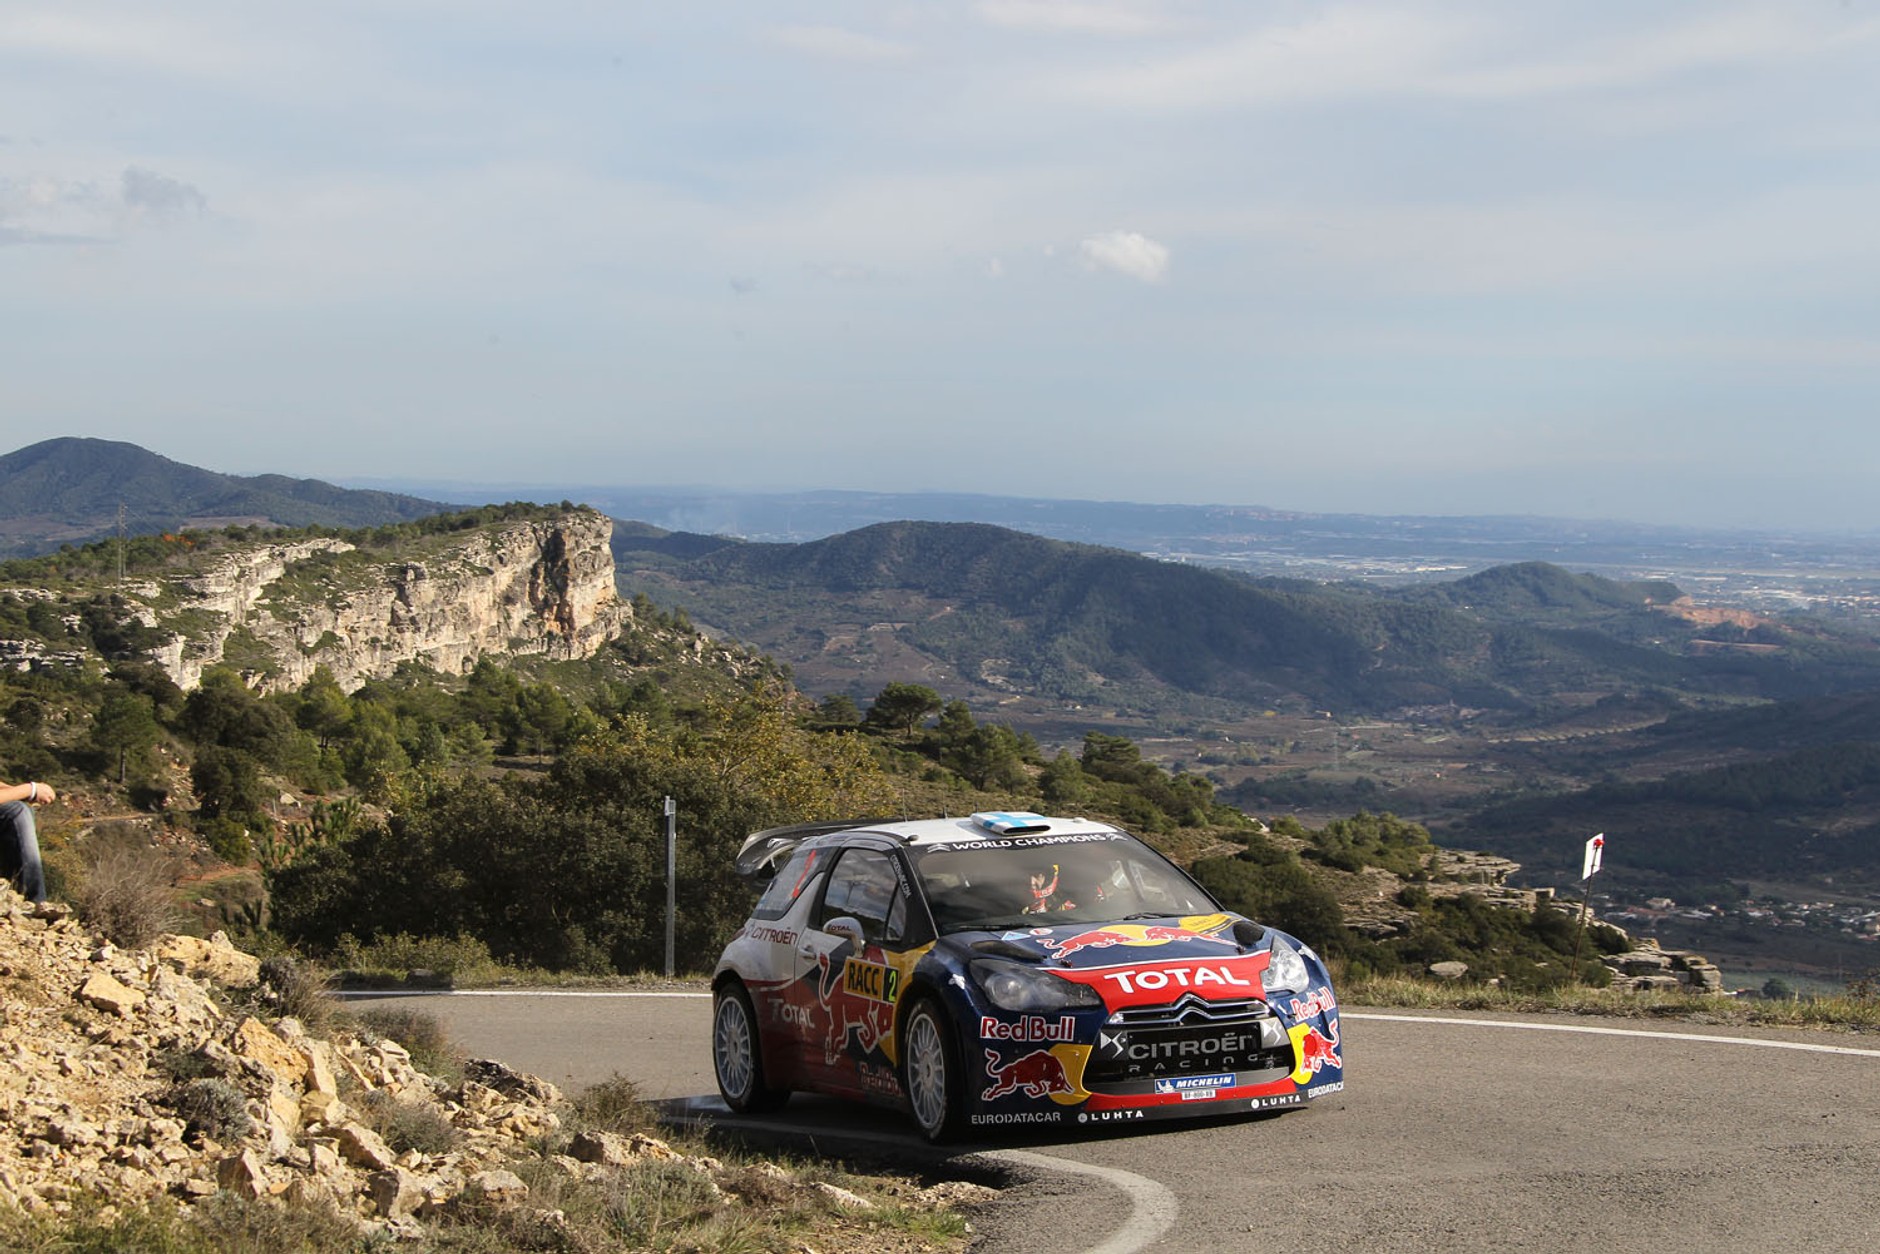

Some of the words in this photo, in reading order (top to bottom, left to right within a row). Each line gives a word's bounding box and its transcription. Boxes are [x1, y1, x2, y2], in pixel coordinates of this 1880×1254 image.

[952, 839, 1012, 850] WORLD
[1015, 833, 1106, 847] CHAMPIONS
[847, 961, 879, 995] RACC
[888, 970, 896, 1002] 2
[1103, 966, 1250, 993] TOTAL
[767, 998, 815, 1028] TOTAL
[1176, 1076, 1232, 1088] MICHELIN
[1262, 1095, 1301, 1107] LUHTA
[971, 1112, 1061, 1124] EURODATACAR
[1091, 1110, 1144, 1121] LUHTA
